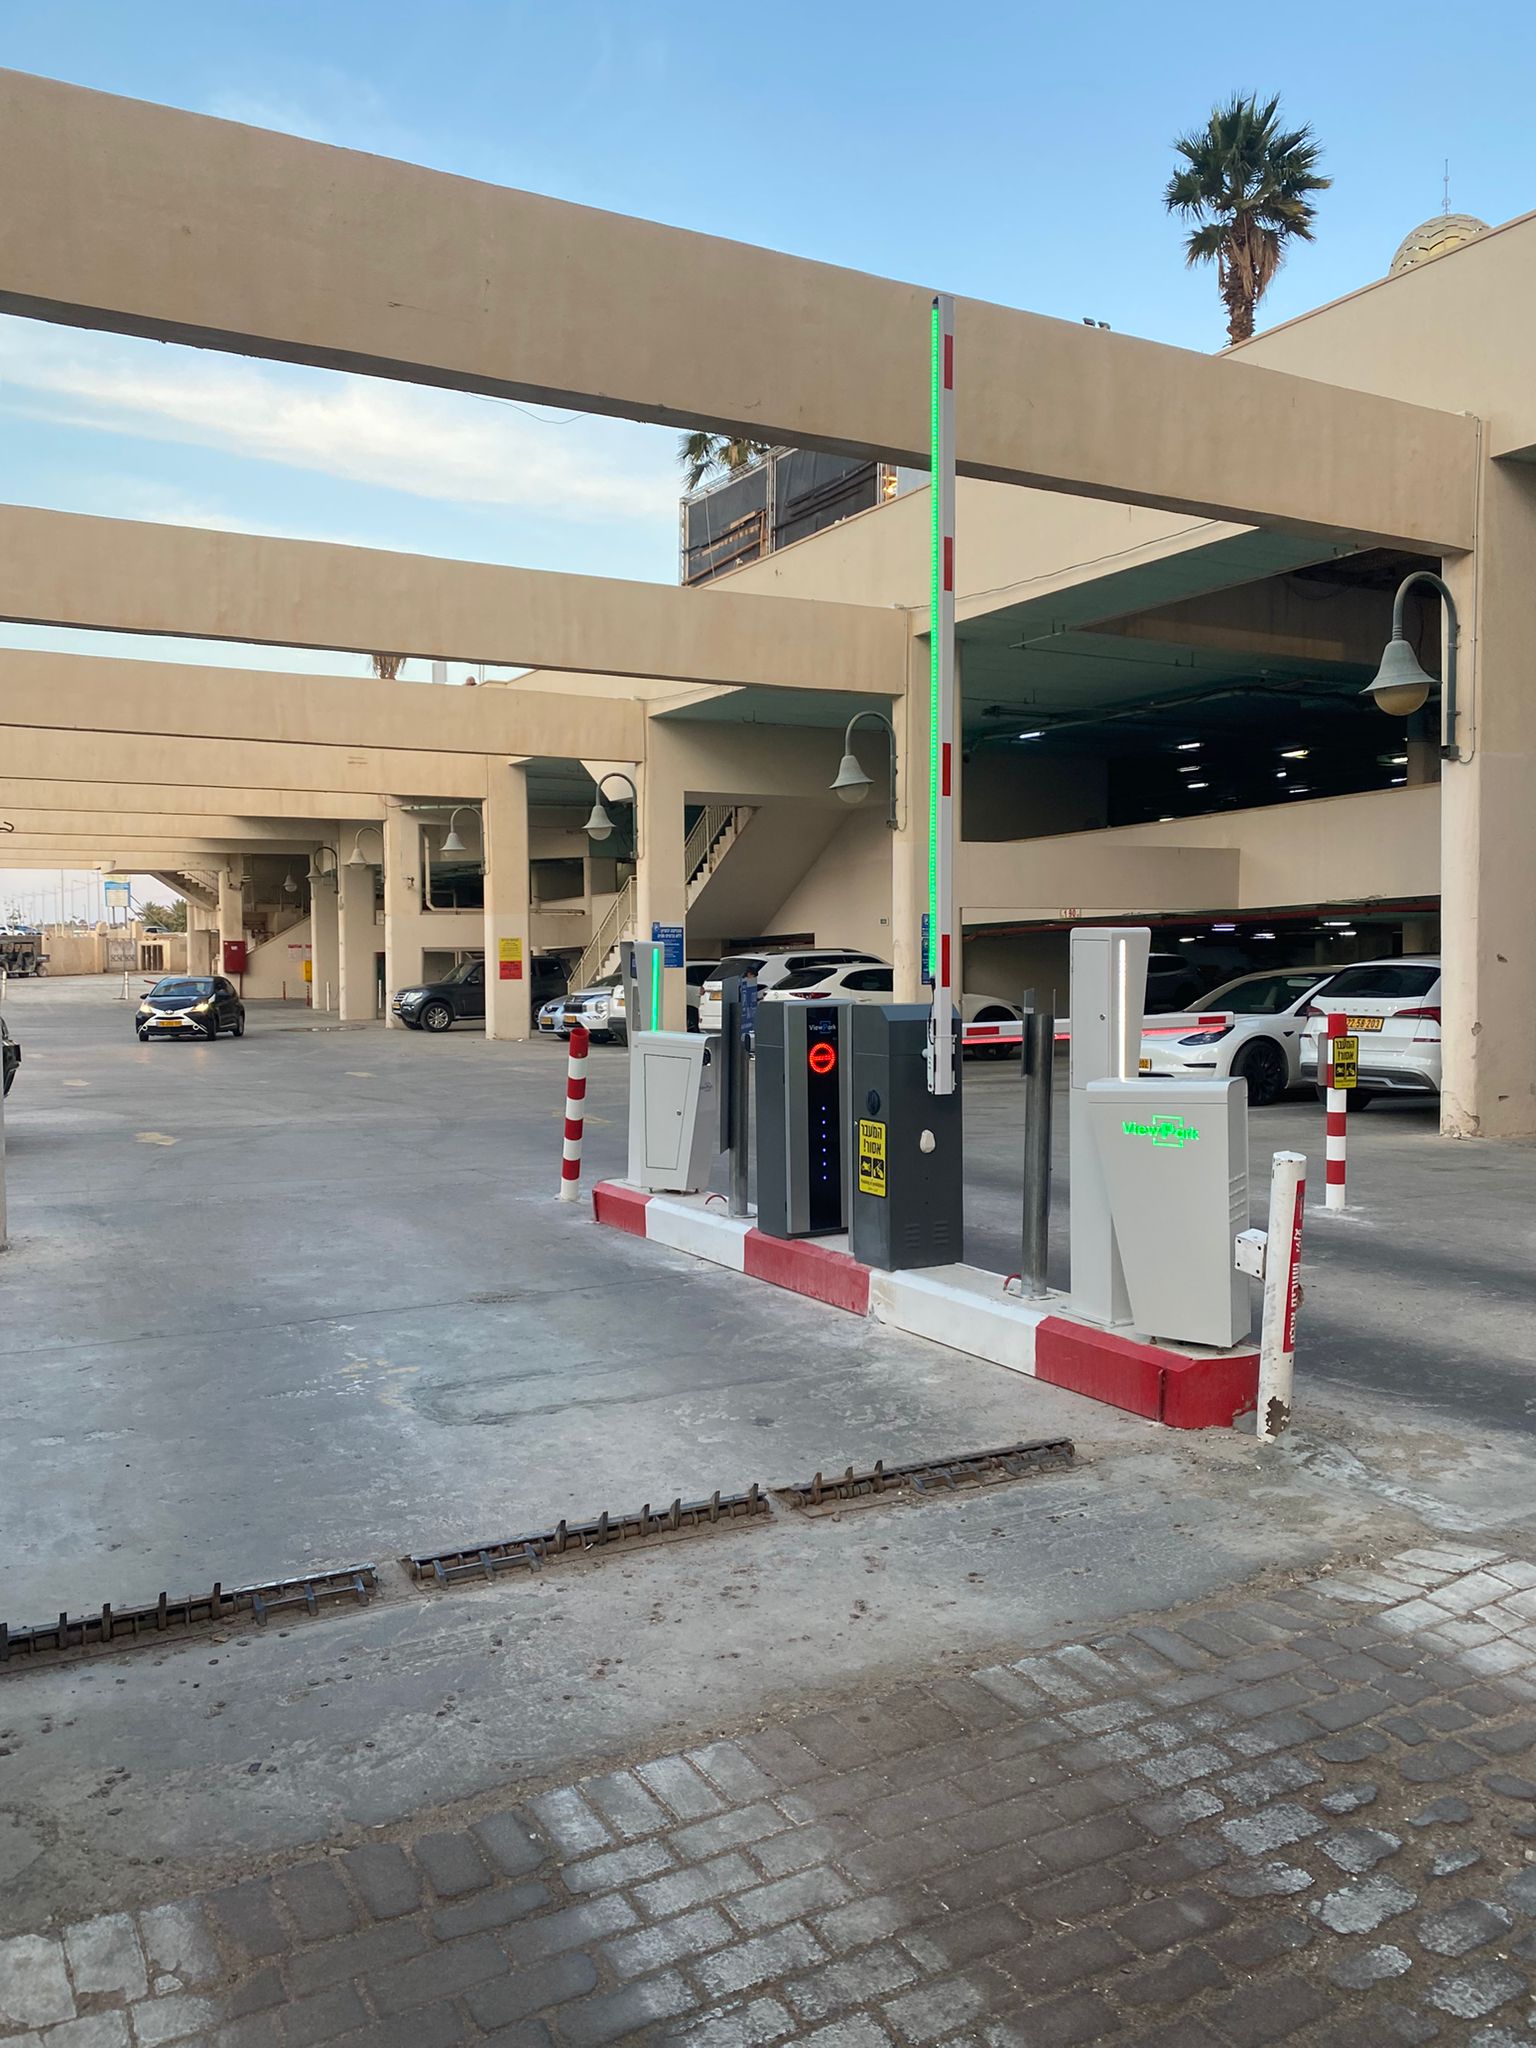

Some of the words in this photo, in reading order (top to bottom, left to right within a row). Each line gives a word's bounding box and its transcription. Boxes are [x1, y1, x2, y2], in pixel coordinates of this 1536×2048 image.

[861, 1124, 882, 1139] המעבר
[1122, 1121, 1199, 1140] ViewPark
[863, 1139, 881, 1155] אסור!
